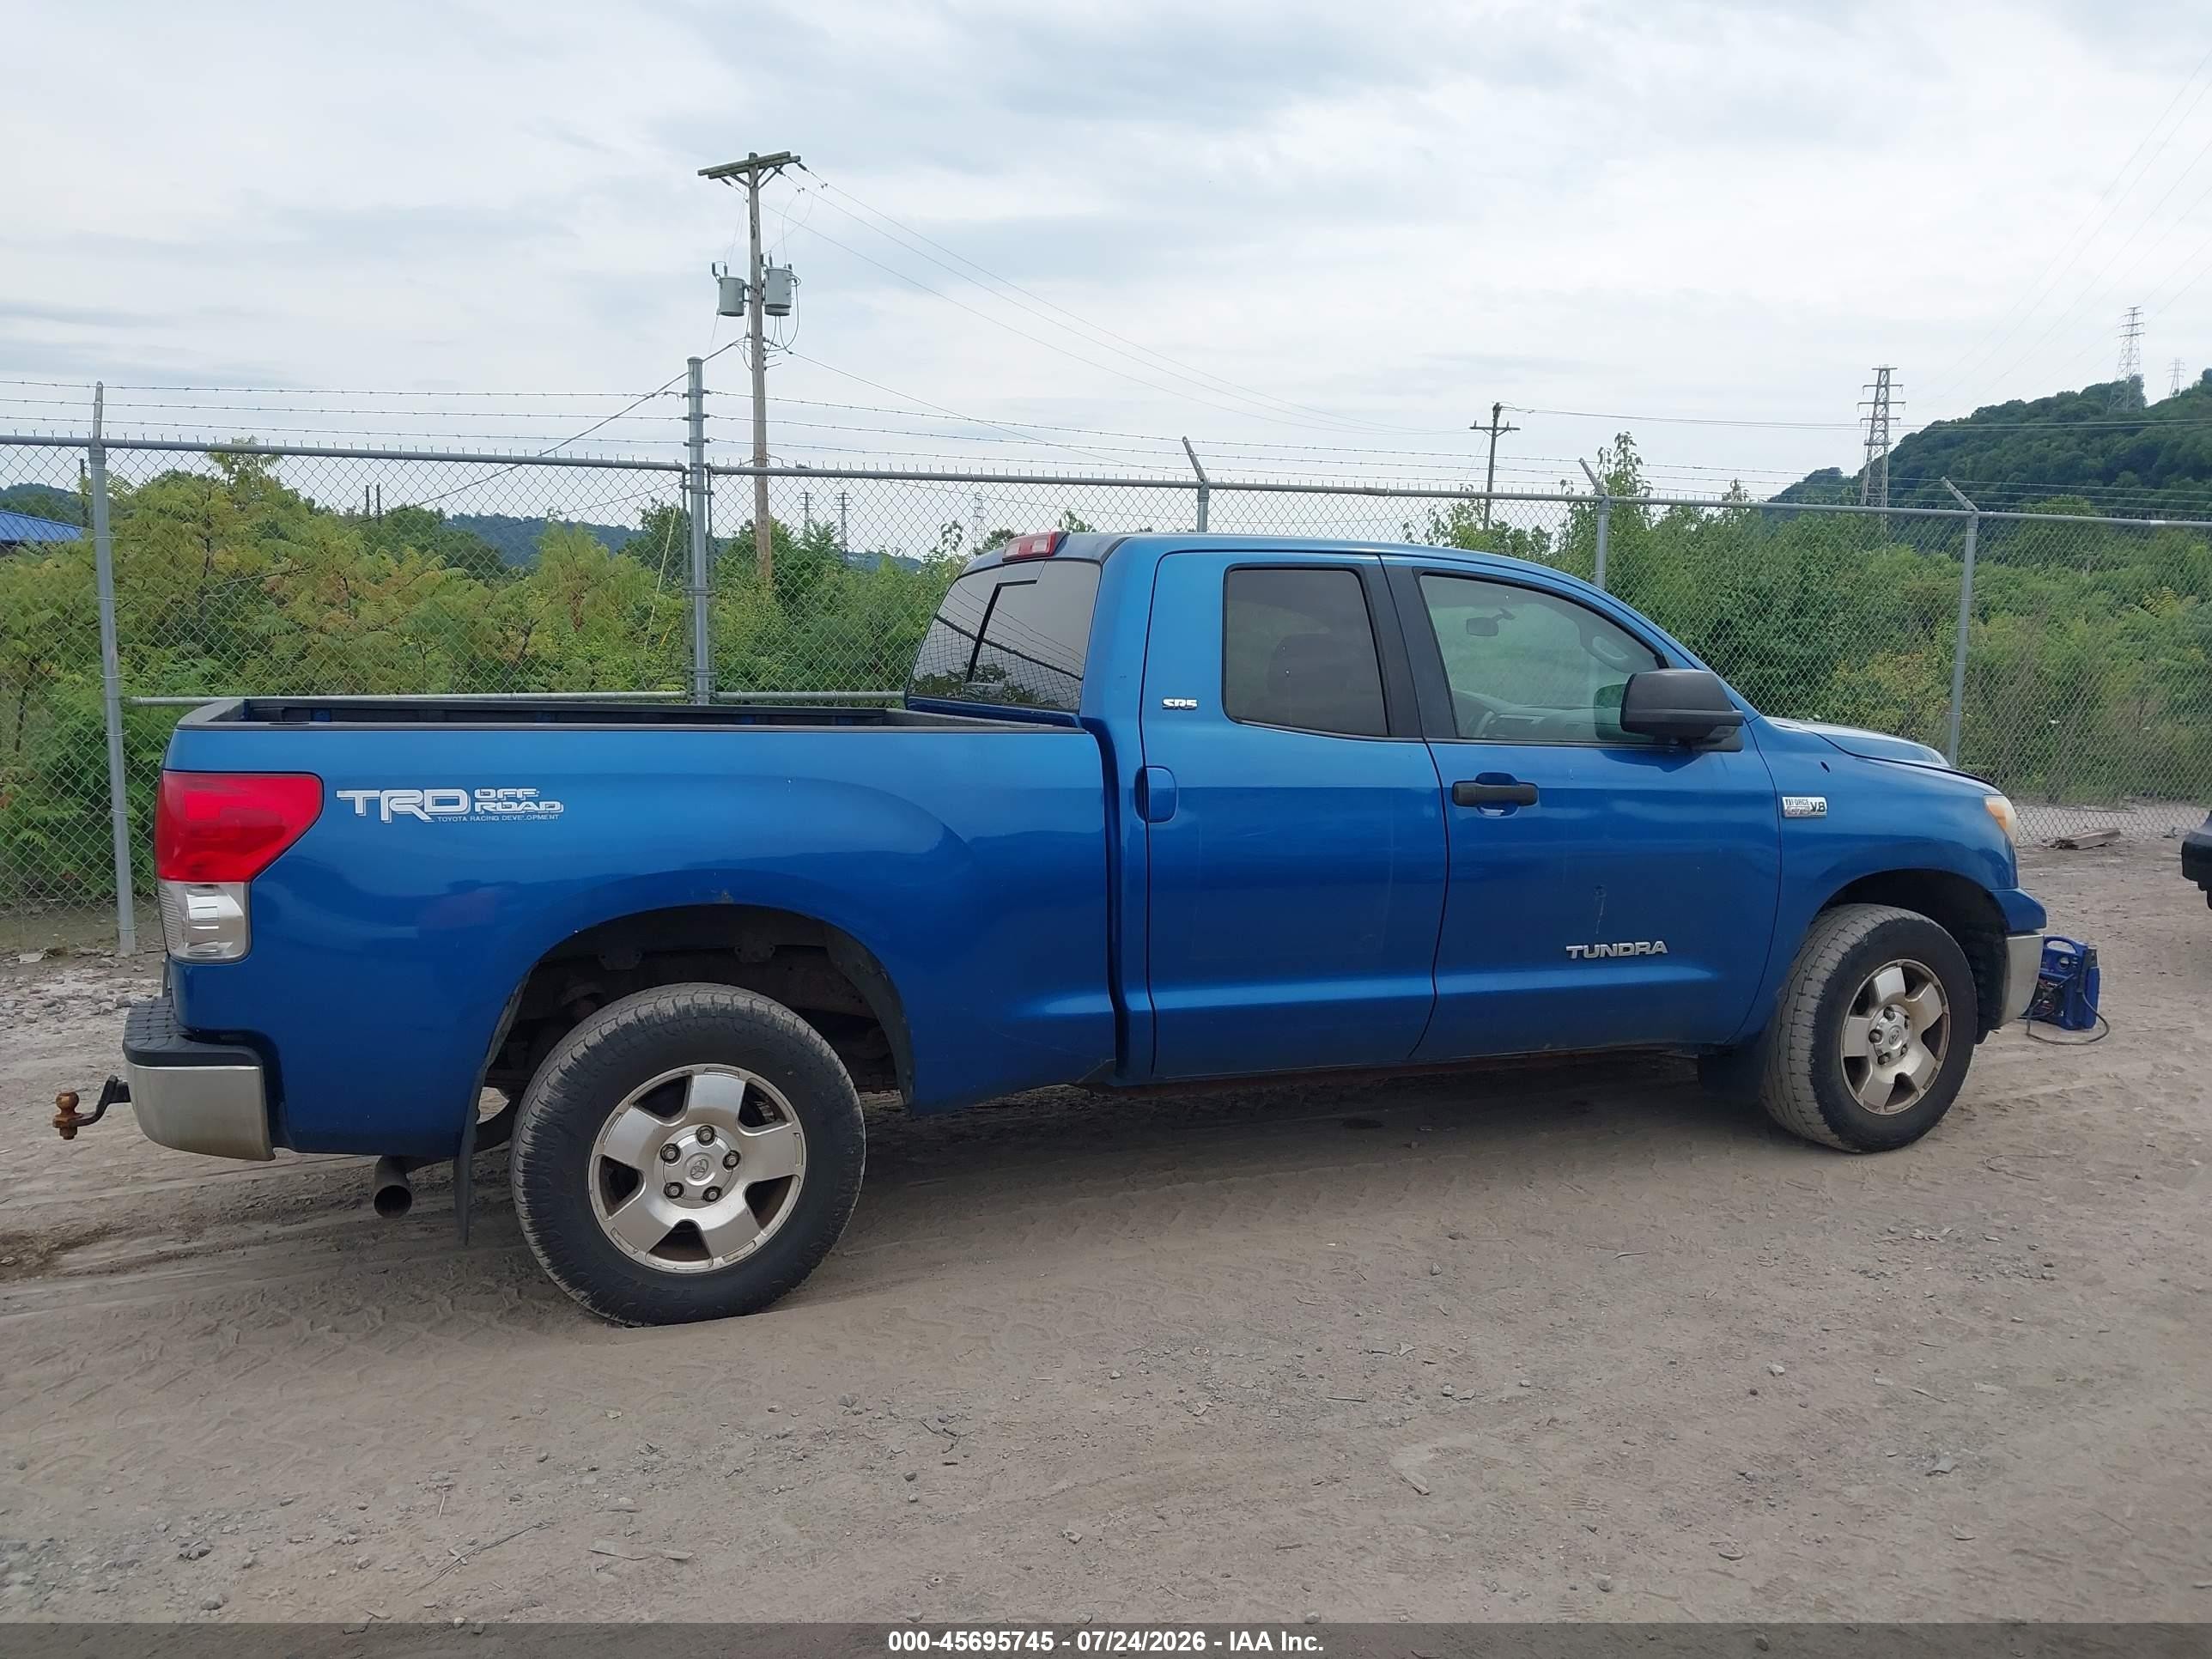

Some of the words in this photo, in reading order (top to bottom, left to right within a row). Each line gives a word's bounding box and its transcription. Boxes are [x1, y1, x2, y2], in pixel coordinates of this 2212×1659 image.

[1162, 698, 1198, 709] SR5
[474, 788, 540, 800] OFF
[336, 789, 471, 823] TRD
[474, 800, 564, 814] ROAD
[1809, 801, 1826, 812] V8
[1565, 940, 1668, 959] TUNDRA
